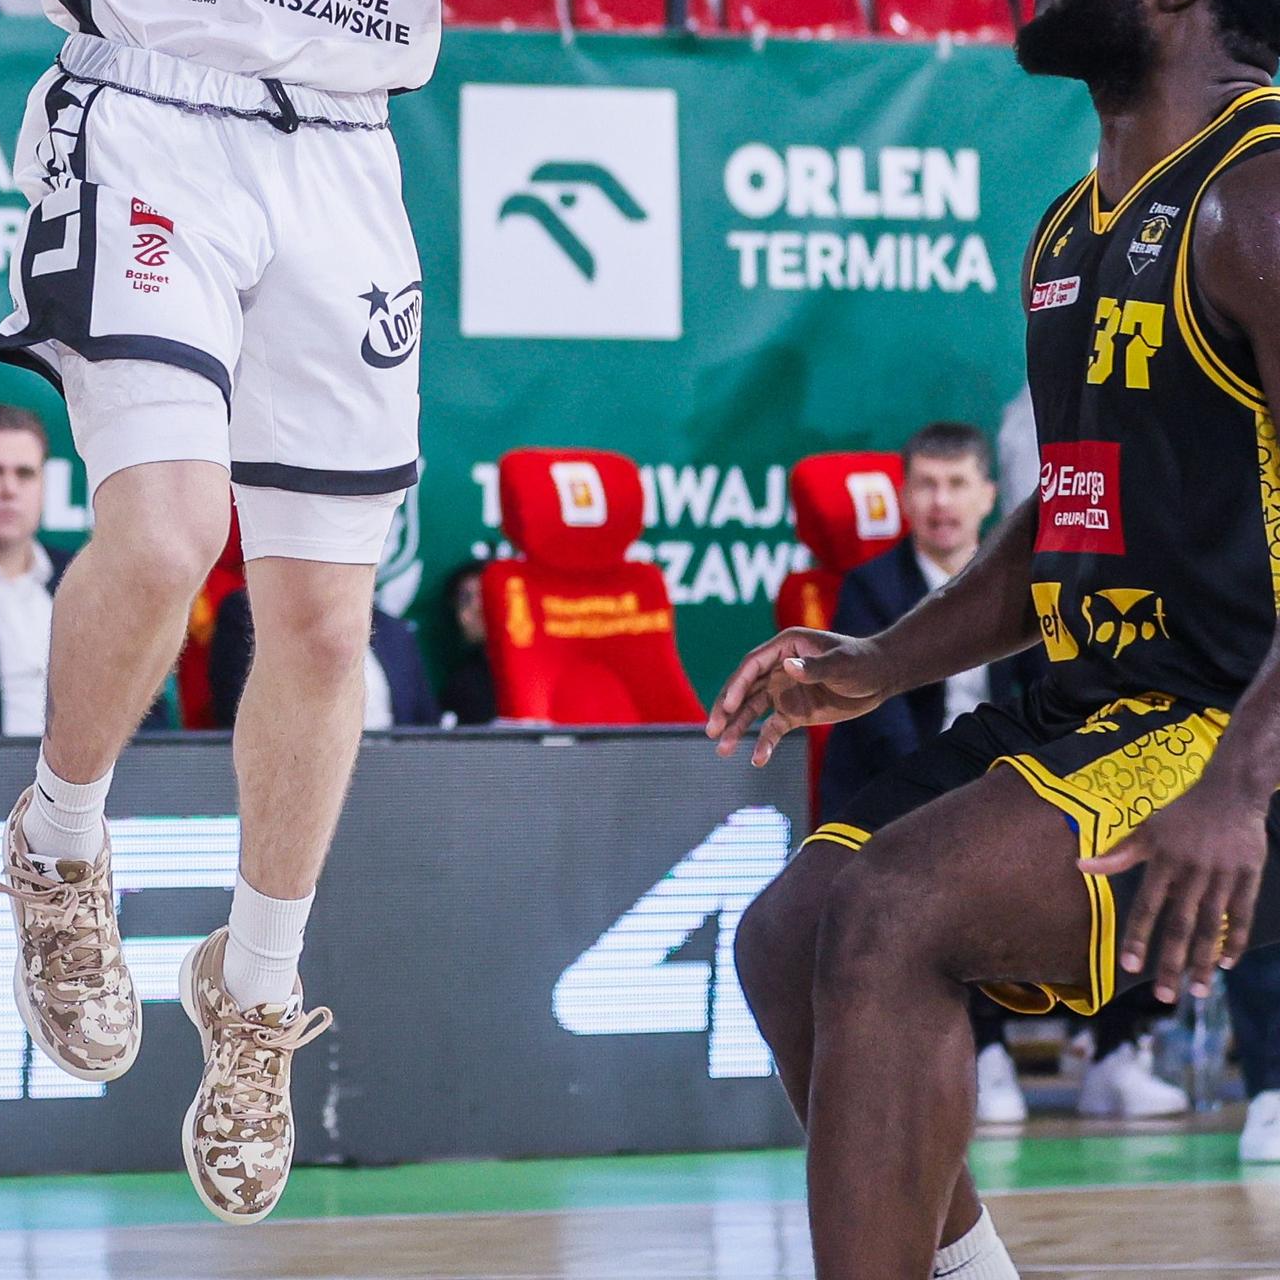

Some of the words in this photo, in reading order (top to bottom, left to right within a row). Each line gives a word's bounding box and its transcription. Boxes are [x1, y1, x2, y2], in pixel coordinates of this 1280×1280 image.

[724, 143, 981, 221] ORLEN
[125, 269, 170, 284] Basket
[132, 280, 161, 294] Liga
[725, 231, 998, 294] TERMIKA
[379, 295, 420, 353] LOTTO
[1086, 296, 1166, 390] 37
[1058, 465, 1105, 505] Energa
[552, 805, 792, 1078] 4
